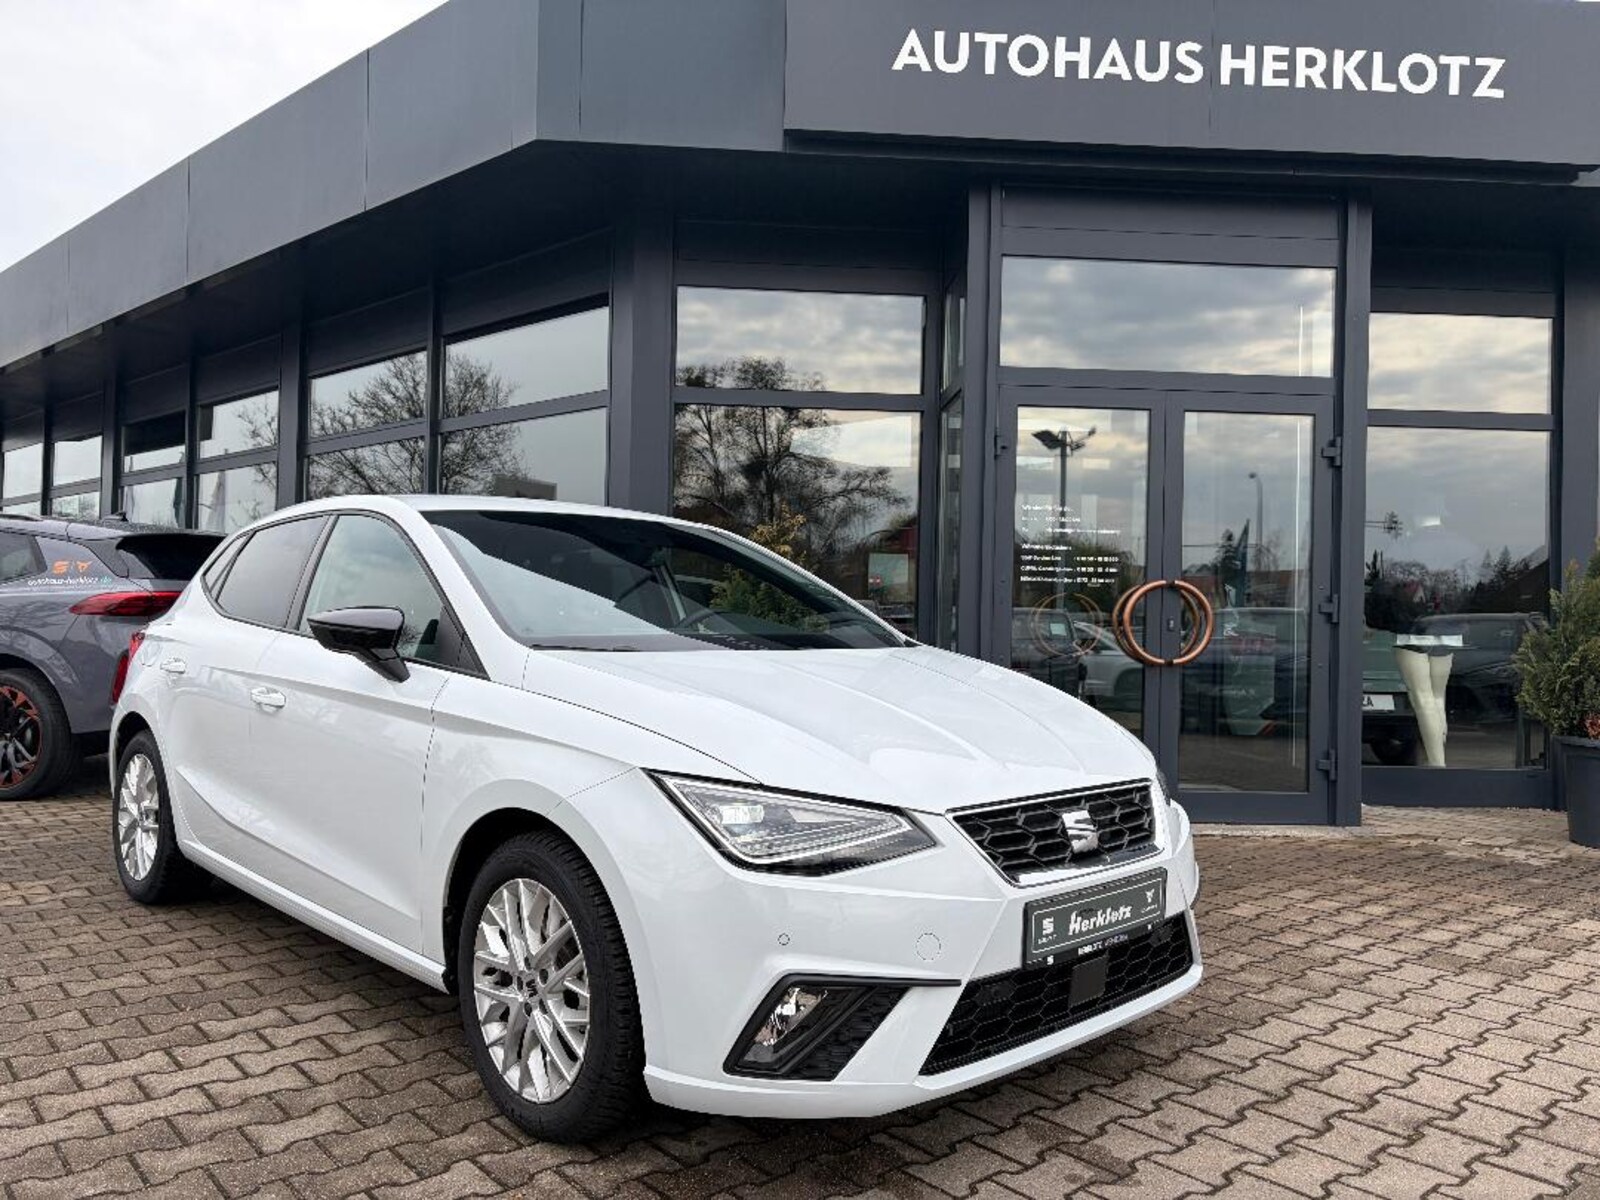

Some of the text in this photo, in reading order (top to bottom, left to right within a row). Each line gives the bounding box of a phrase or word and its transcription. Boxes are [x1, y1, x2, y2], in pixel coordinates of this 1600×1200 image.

[891, 28, 1506, 99] AUTOHAUS HERKLOTZ
[1068, 904, 1133, 936] Herklotz
